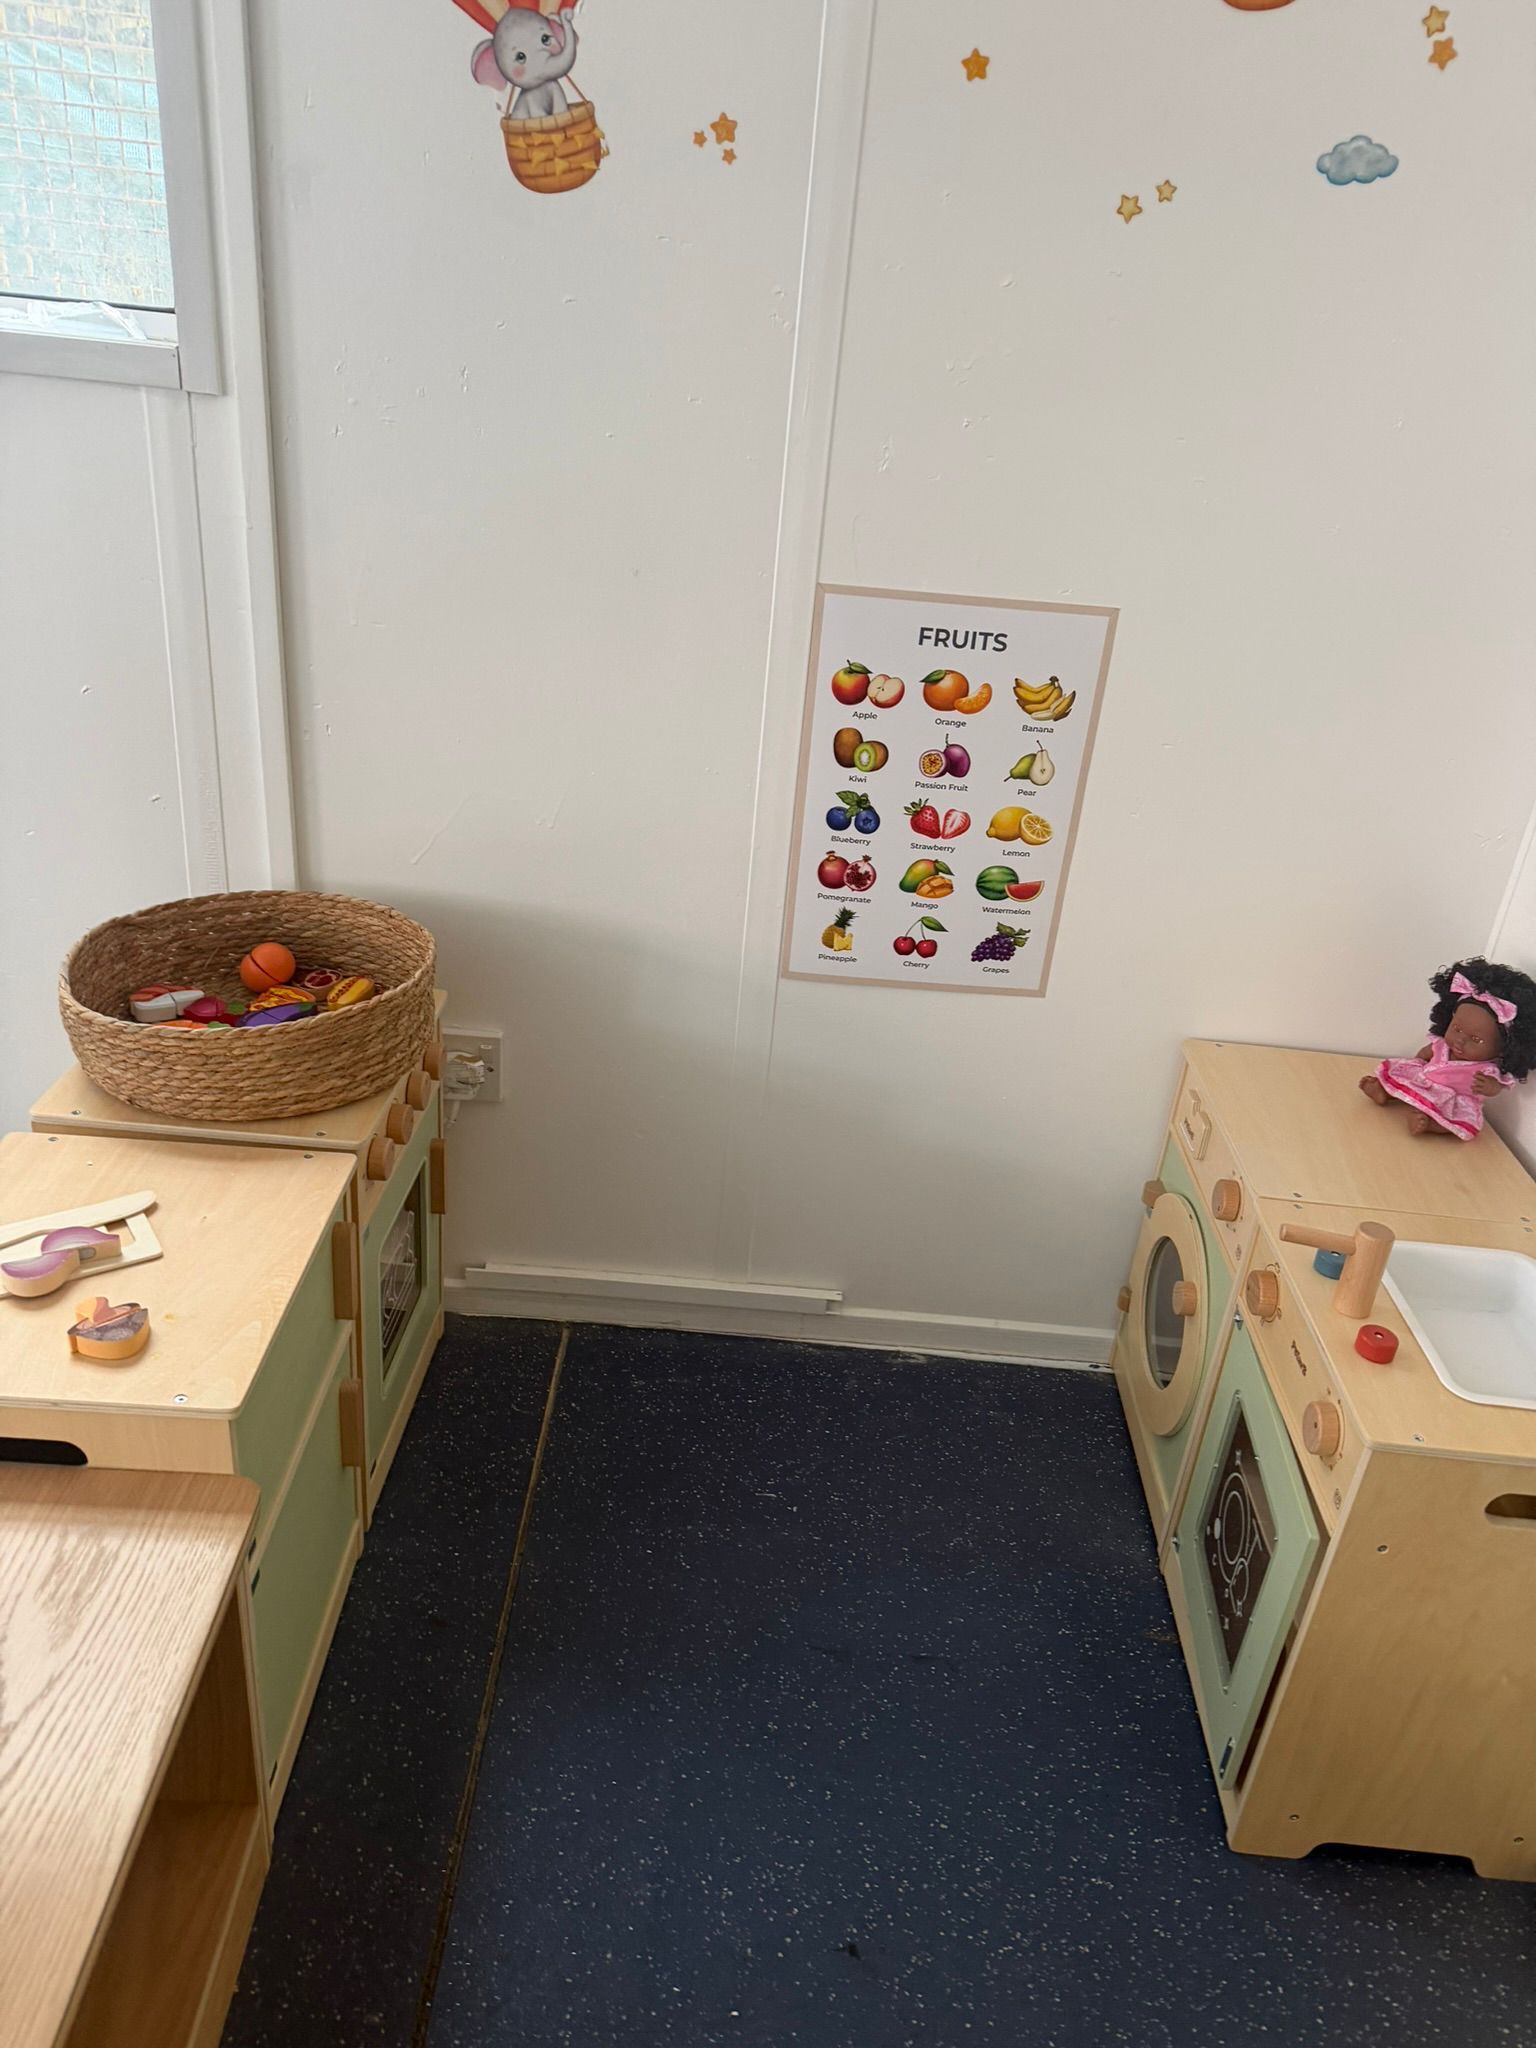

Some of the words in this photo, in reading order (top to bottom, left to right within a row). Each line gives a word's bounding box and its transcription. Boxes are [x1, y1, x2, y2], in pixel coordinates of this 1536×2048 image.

[918, 627, 1008, 652] FRUITS
[852, 711, 878, 721] Apple
[935, 718, 967, 728] Orange
[1022, 725, 1054, 734] Banana
[849, 775, 867, 784] Kiwi
[915, 781, 946, 790] Passion
[949, 784, 968, 792] Fruit
[1017, 789, 1036, 797] Pear
[831, 835, 871, 846] Blueberry
[910, 843, 956, 853] Strawberry
[1002, 850, 1030, 858] Lemon
[817, 892, 871, 903] Pomegranate
[911, 902, 938, 910] Mango
[982, 907, 1031, 916] Watermelon
[818, 954, 857, 964] Pineapple
[903, 961, 930, 969] Cherry
[982, 967, 1010, 975] Grapes
